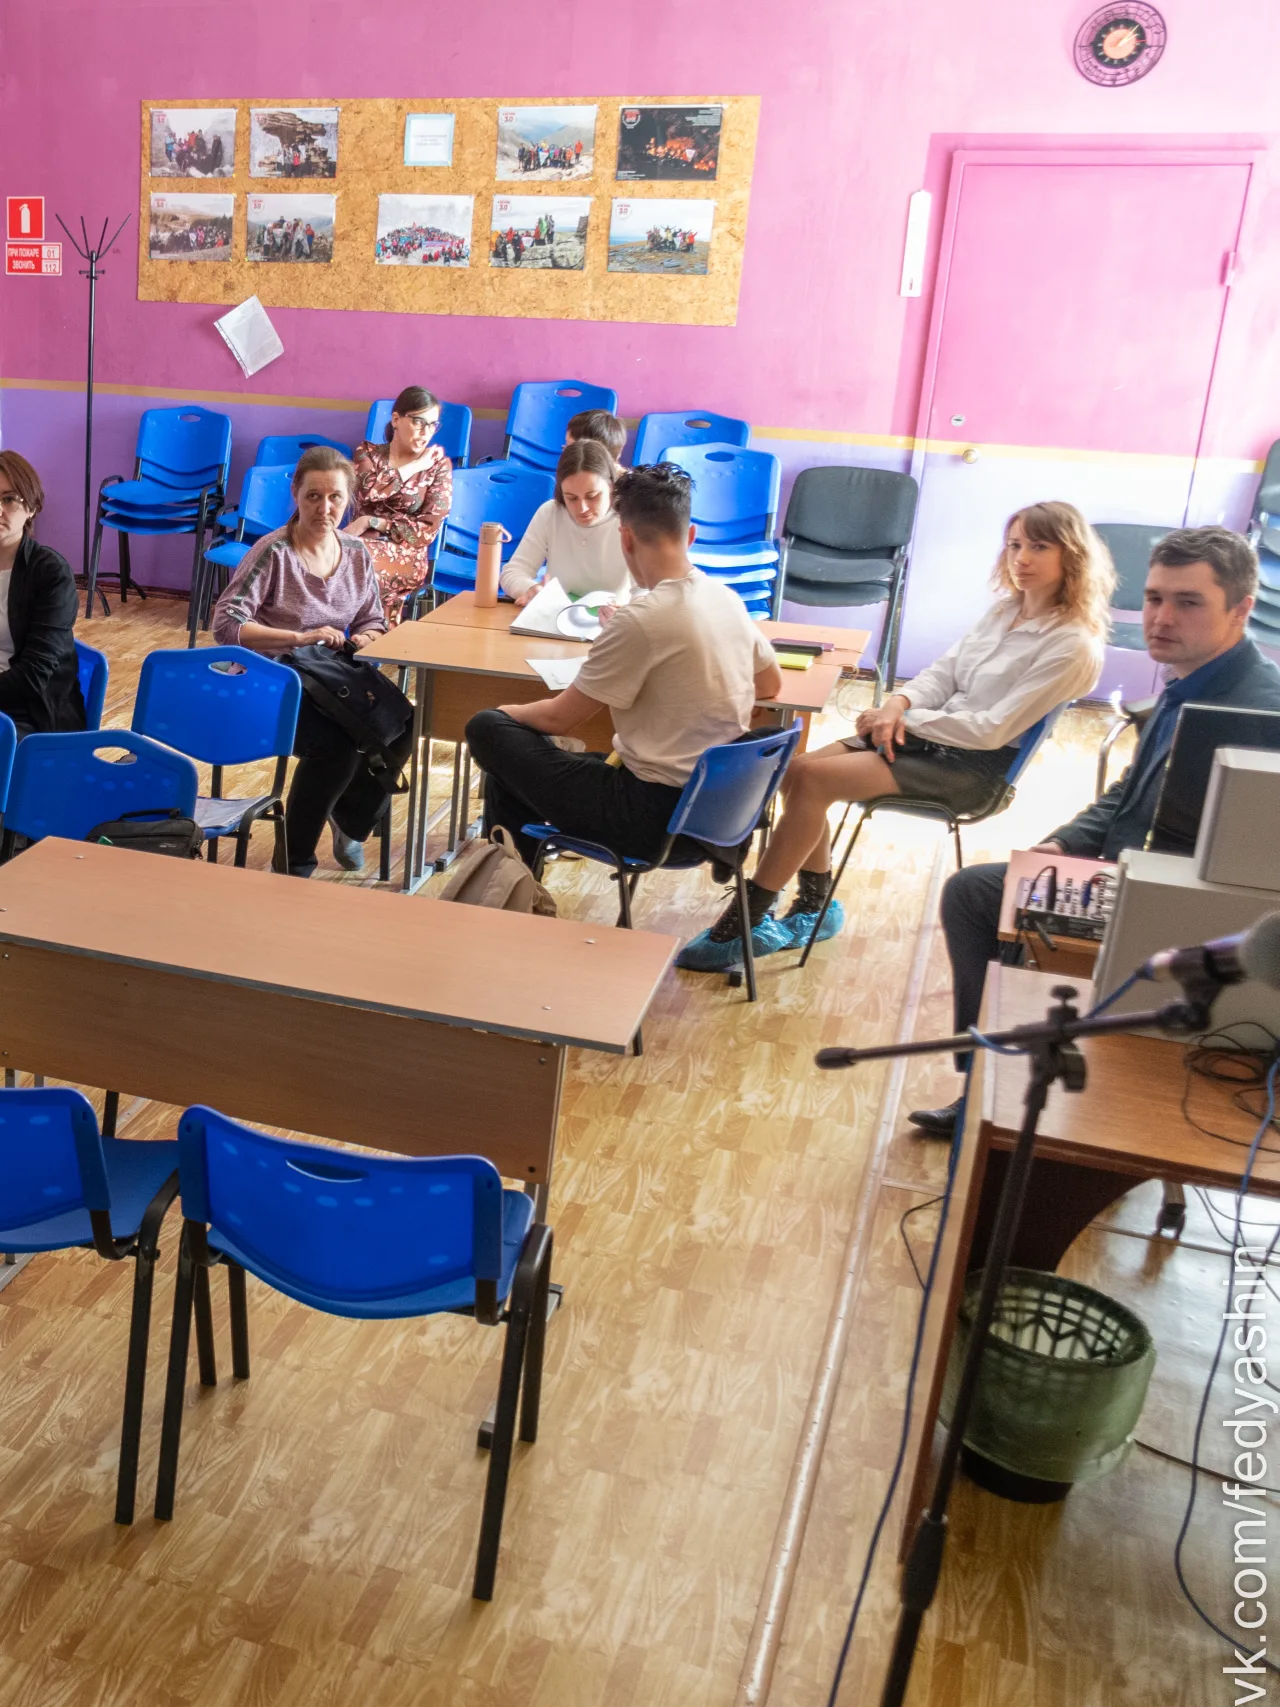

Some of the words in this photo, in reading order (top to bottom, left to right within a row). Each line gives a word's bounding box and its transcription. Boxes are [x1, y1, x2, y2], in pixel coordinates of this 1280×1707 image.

[8, 248, 18, 257] ПРИ
[19, 248, 39, 257] ПОЖАРЕ
[46, 249, 55, 258] 01
[45, 263, 56, 272] 112
